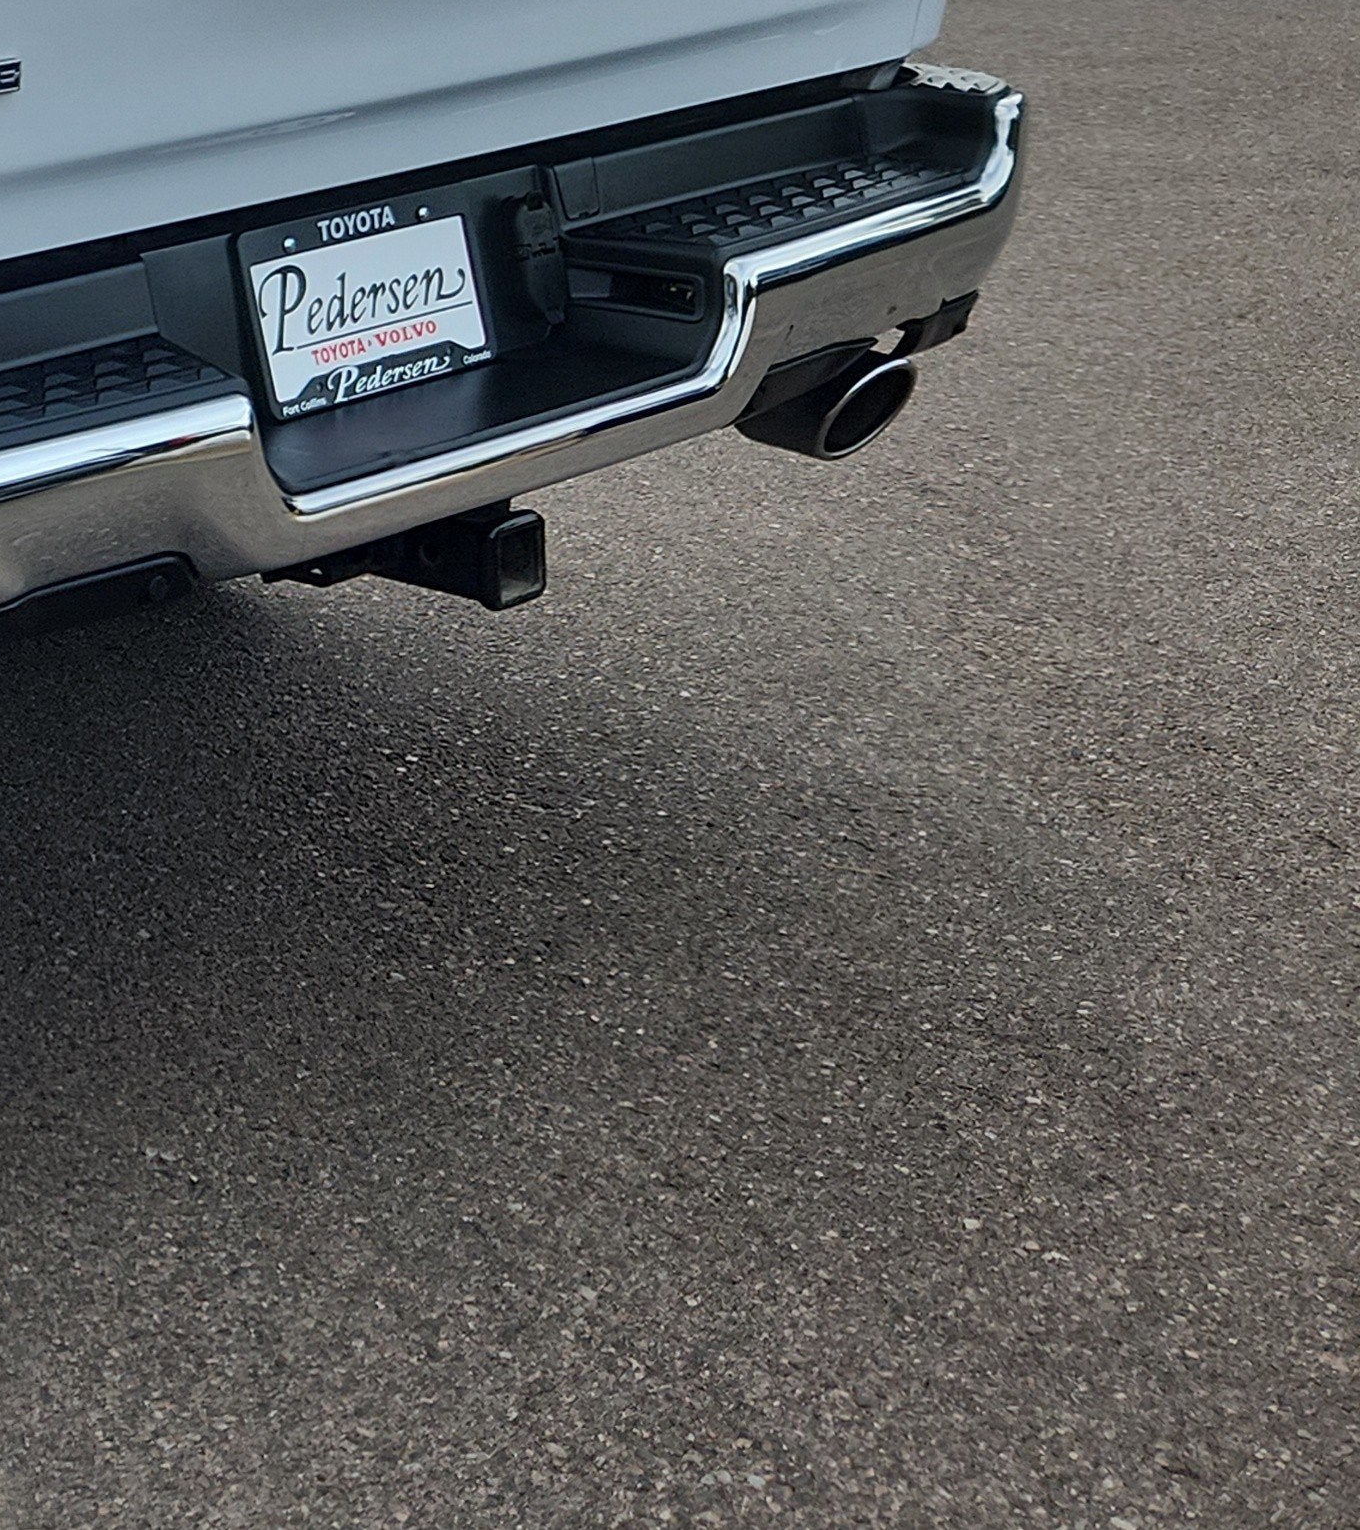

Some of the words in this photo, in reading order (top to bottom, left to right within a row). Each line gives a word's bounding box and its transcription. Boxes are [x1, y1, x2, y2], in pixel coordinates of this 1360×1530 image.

[316, 205, 395, 241] TOYOTA
[258, 265, 466, 356] Pedersen
[311, 337, 366, 366] TOYOTA
[374, 320, 437, 347] VOLVO
[327, 355, 451, 404] Pedersen
